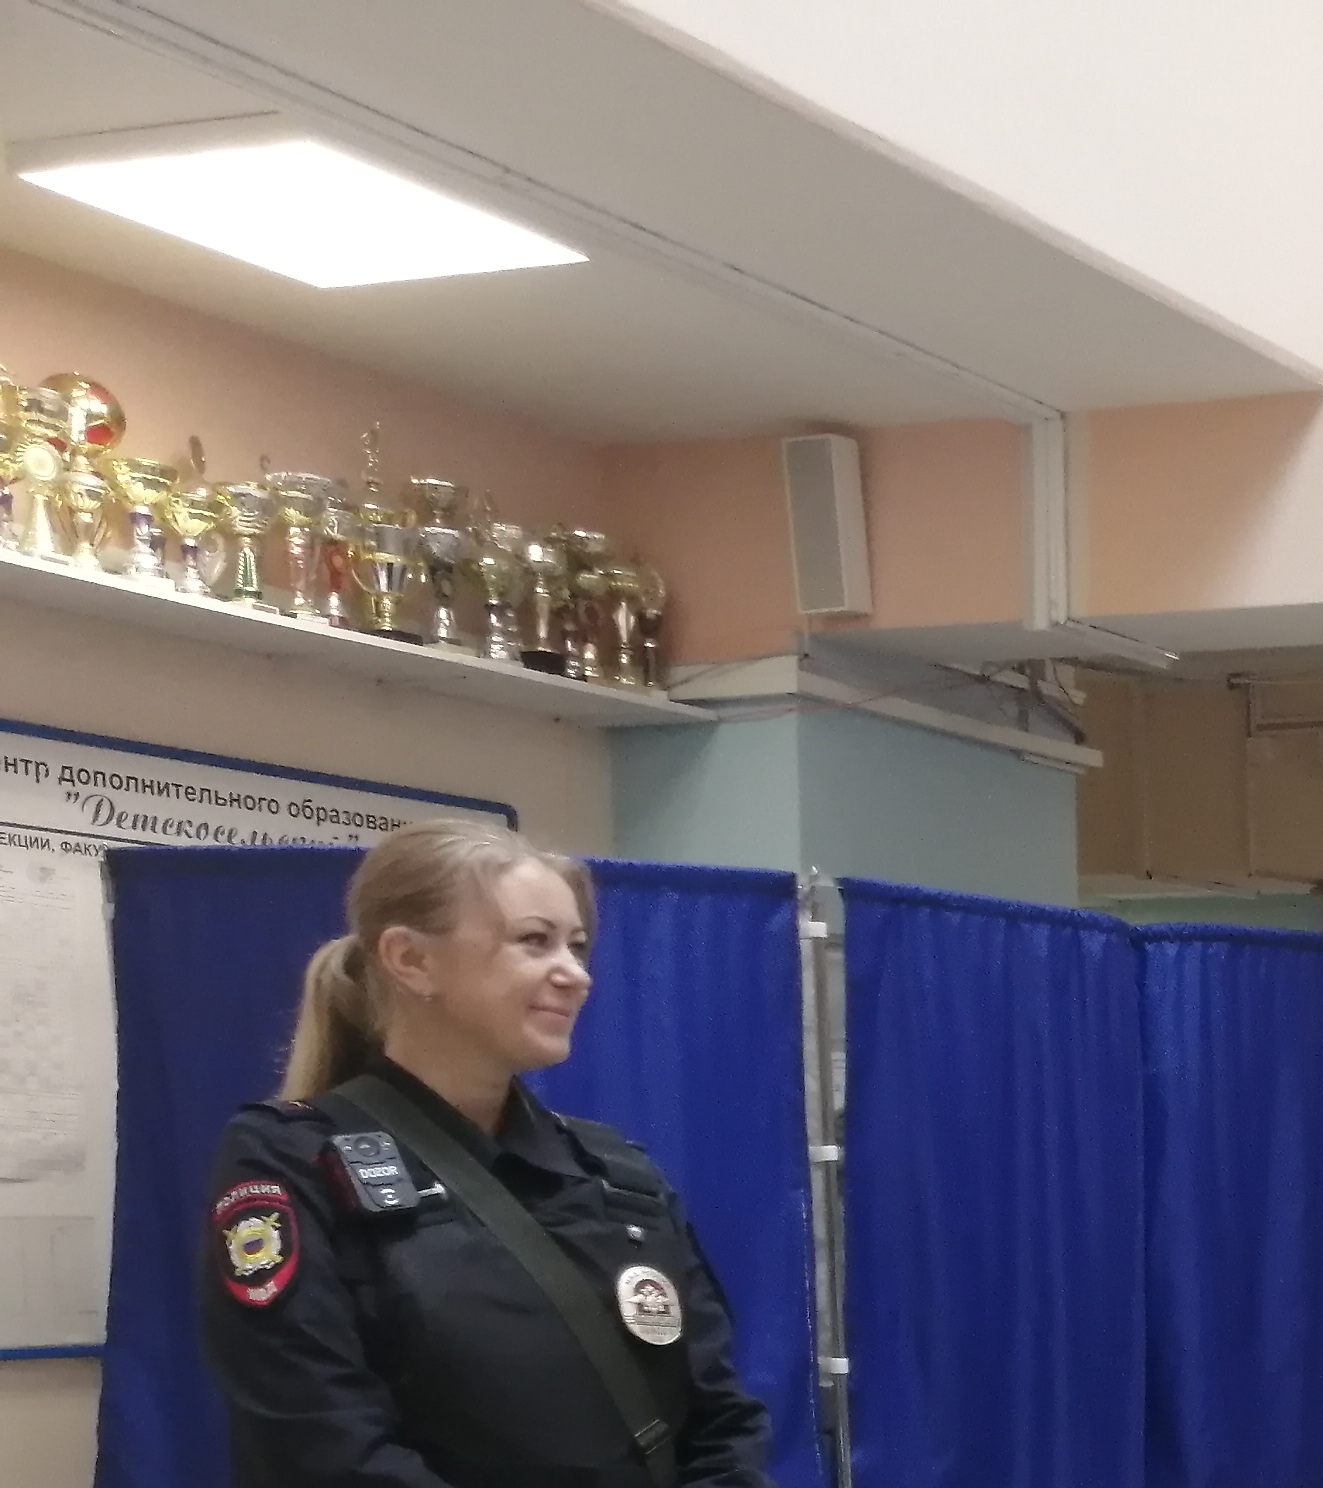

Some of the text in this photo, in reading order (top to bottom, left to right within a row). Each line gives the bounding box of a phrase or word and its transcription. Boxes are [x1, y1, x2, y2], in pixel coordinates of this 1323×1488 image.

[0, 756, 414, 833] нтр дополнительного образован
[60, 841, 102, 857] ФАКУ
